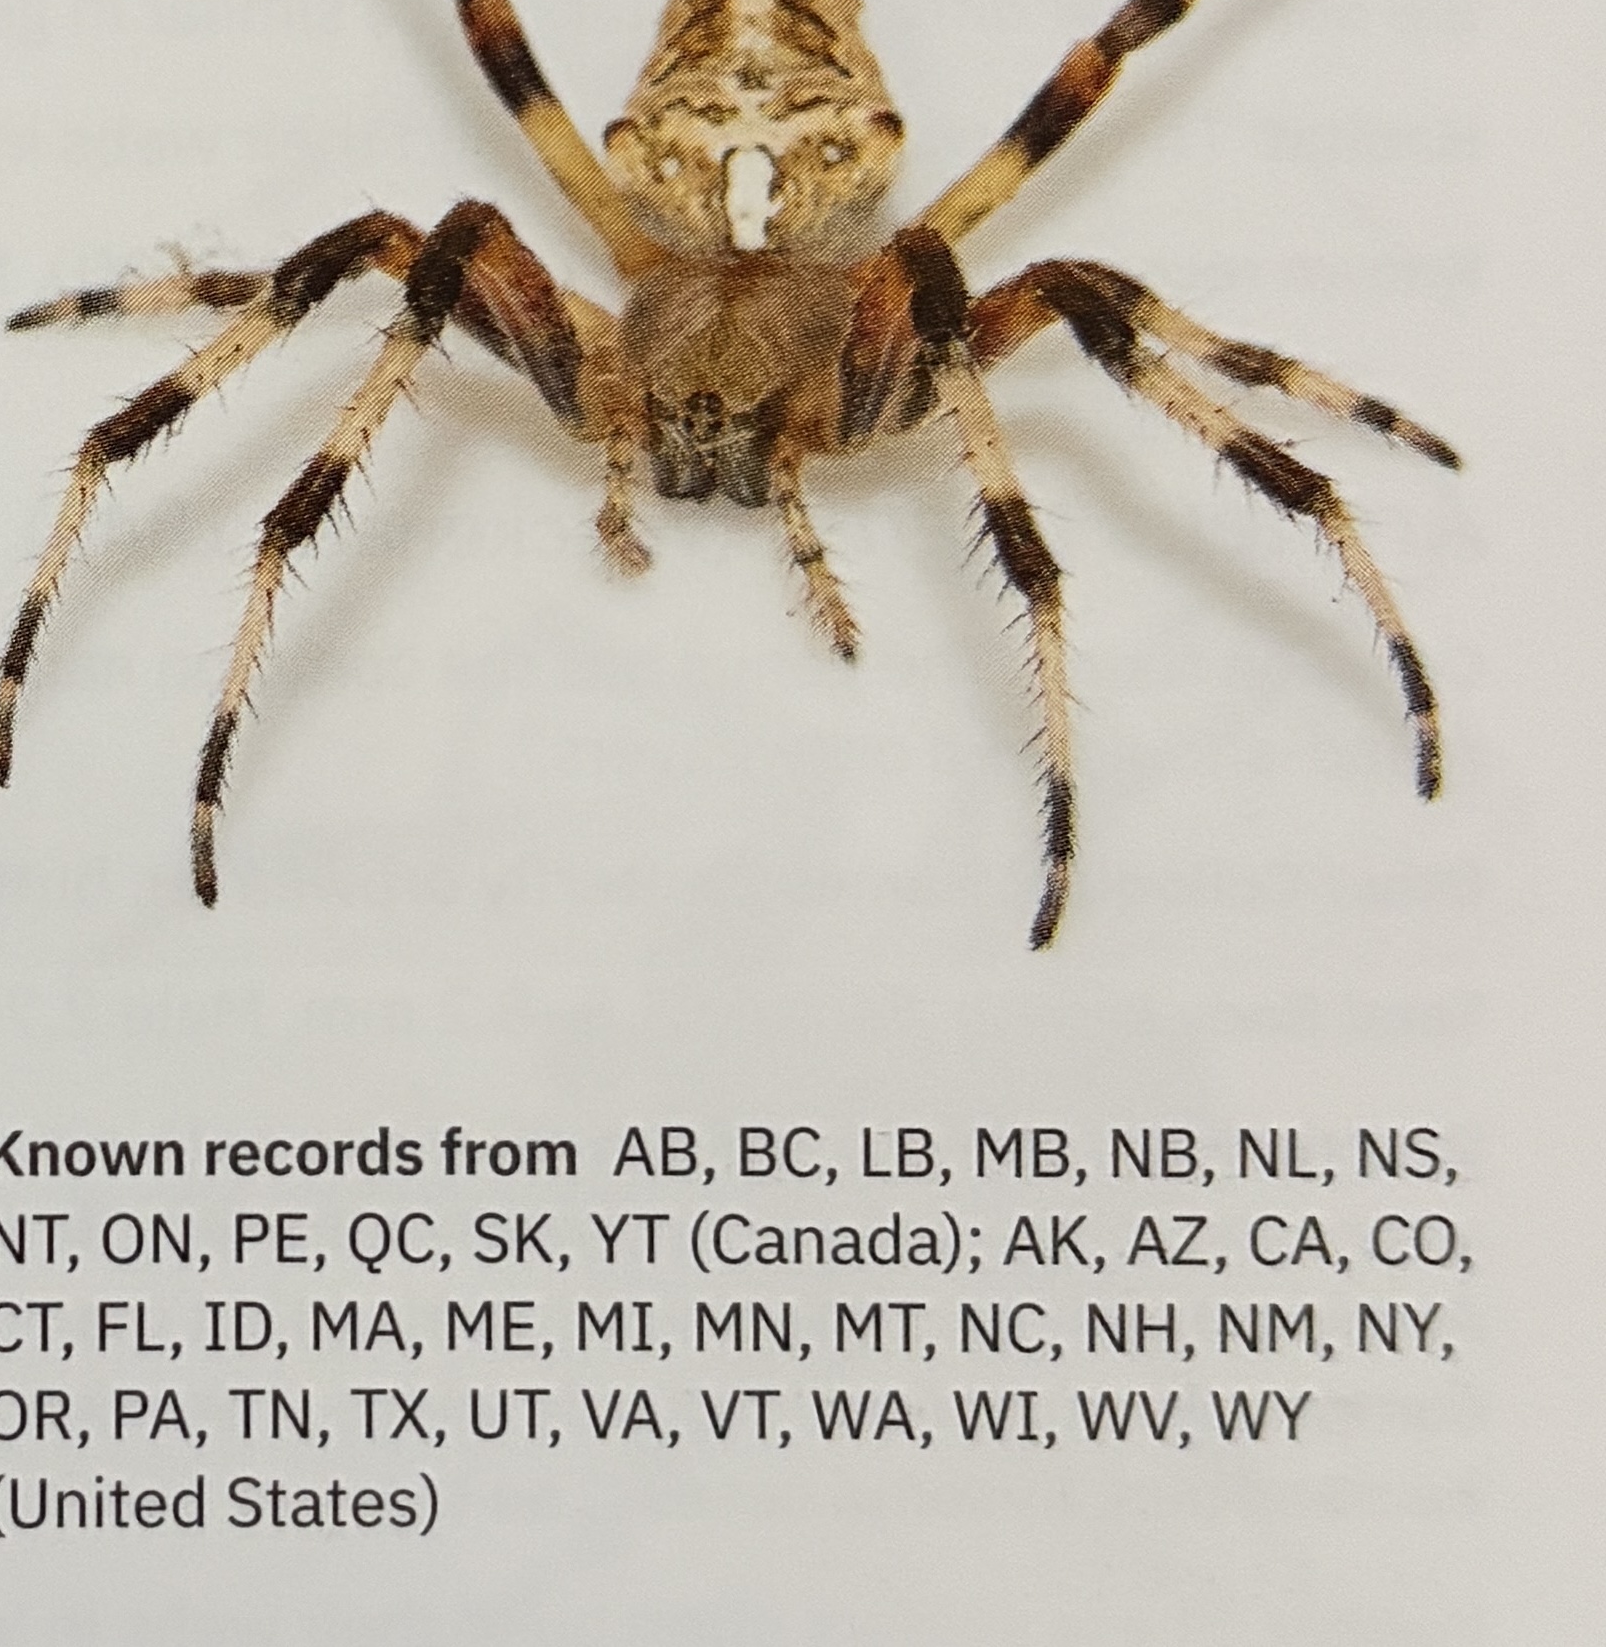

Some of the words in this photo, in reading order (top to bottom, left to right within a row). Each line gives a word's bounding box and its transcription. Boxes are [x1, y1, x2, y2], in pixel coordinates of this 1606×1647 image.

[206, 1127, 423, 1176] records
[440, 1126, 576, 1176] from
[613, 1126, 715, 1185] AB,
[740, 1127, 837, 1186] BC,
[863, 1127, 951, 1186] LB,
[977, 1128, 1087, 1187] MB,
[1112, 1128, 1214, 1187] NB,
[1240, 1128, 1334, 1187] NL,
[1359, 1128, 1457, 1186] NS,
[102, 1213, 210, 1273] ON,
[235, 1213, 325, 1272] PE,
[349, 1212, 451, 1274] QC,
[474, 1212, 570, 1272] SK,
[591, 1214, 670, 1264] YT
[692, 1210, 981, 1274] (Canada);
[1003, 1215, 1105, 1274] AK,
[1127, 1216, 1226, 1274] AZ,
[1251, 1215, 1349, 1274] CA,
[1373, 1215, 1472, 1273] CO,
[99, 1301, 182, 1360] FL,
[205, 1301, 287, 1360] ID,
[313, 1301, 422, 1360] MA,
[448, 1301, 553, 1360] ME,
[578, 1301, 671, 1360] MI,
[697, 1302, 811, 1361] MN,
[837, 1303, 935, 1362] MT,
[962, 1303, 1062, 1362] NC,
[1088, 1303, 1194, 1362] NH,
[1220, 1303, 1334, 1362] NM,
[1359, 1303, 1453, 1361] NY,
[115, 1389, 207, 1448] PA,
[229, 1389, 329, 1448] TN,
[350, 1388, 445, 1448] TX,
[471, 1389, 560, 1448] UT,
[582, 1389, 679, 1448] VA,
[701, 1390, 791, 1449] VT,
[812, 1390, 932, 1449] WA,
[953, 1391, 1056, 1449] WI,
[1077, 1391, 1190, 1449] WV,
[1212, 1391, 1312, 1441] WY
[228, 1473, 438, 1536] States)
